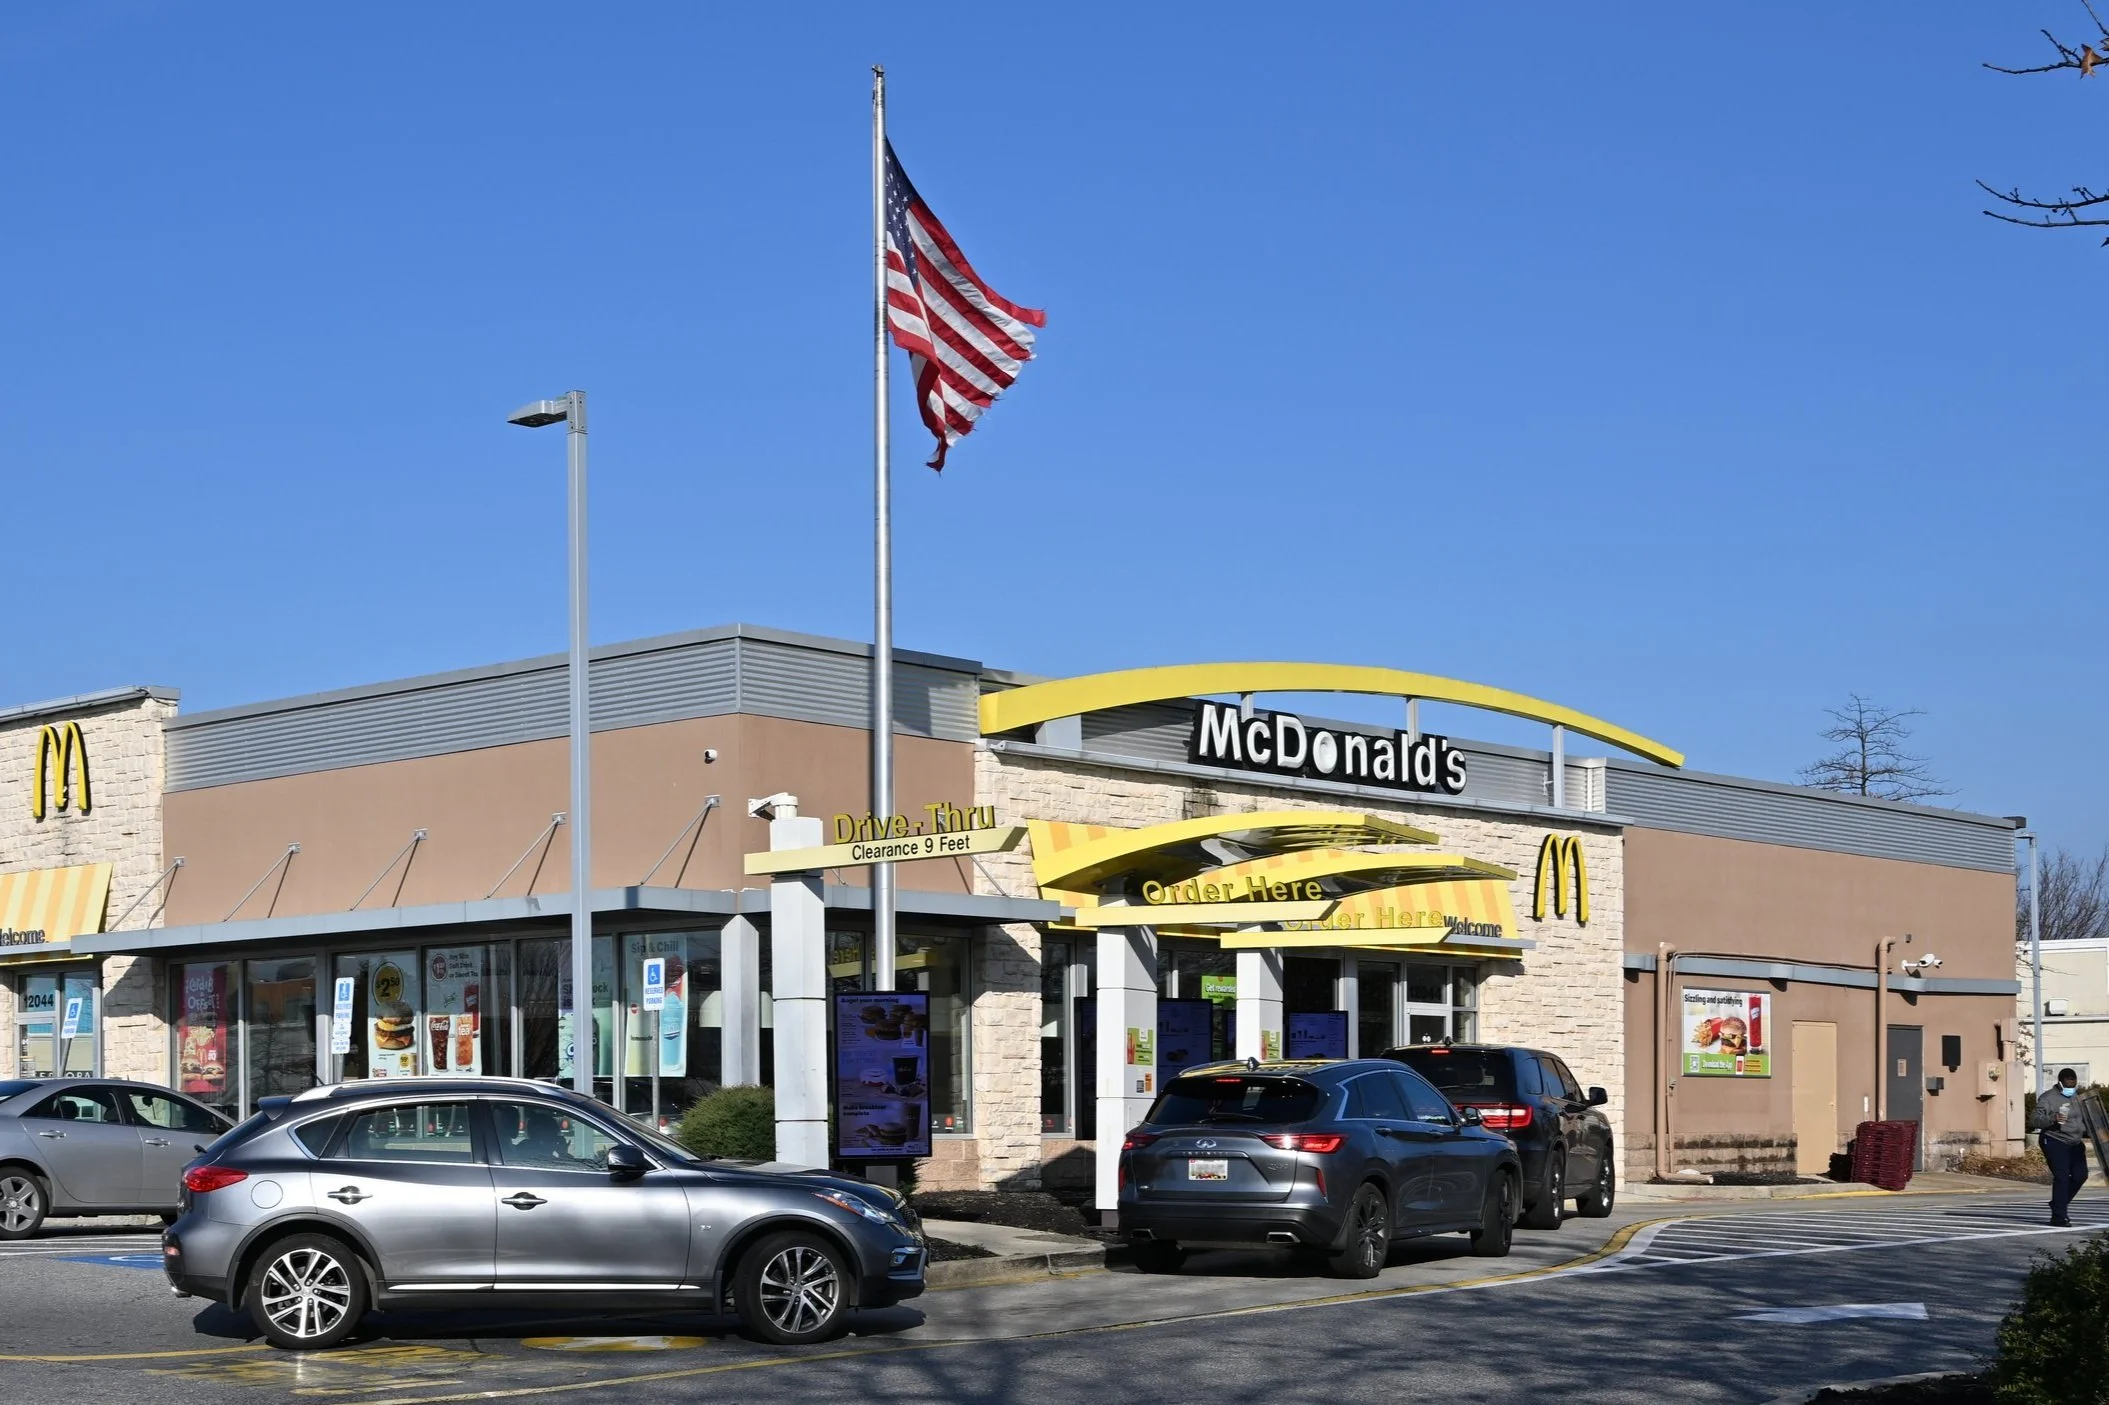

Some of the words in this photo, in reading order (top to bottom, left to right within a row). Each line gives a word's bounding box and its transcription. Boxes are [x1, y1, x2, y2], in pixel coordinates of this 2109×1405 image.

[1199, 703, 1468, 791] McDonald's
[852, 843, 919, 861] Clearance
[924, 837, 934, 853] 9
[939, 834, 971, 852] Feet
[1142, 877, 1235, 905] Order
[1246, 876, 1323, 901] Here
[1376, 906, 1444, 928] Here
[1443, 915, 1503, 938] Welcome
[0, 928, 45, 946] elcome
[631, 943, 646, 955] Sip
[657, 939, 679, 953] Chill
[24, 994, 54, 1009] 12044
[1684, 994, 1706, 1005] Sizzling
[1706, 996, 1717, 1004] and
[1717, 997, 1743, 1007] satisfying
